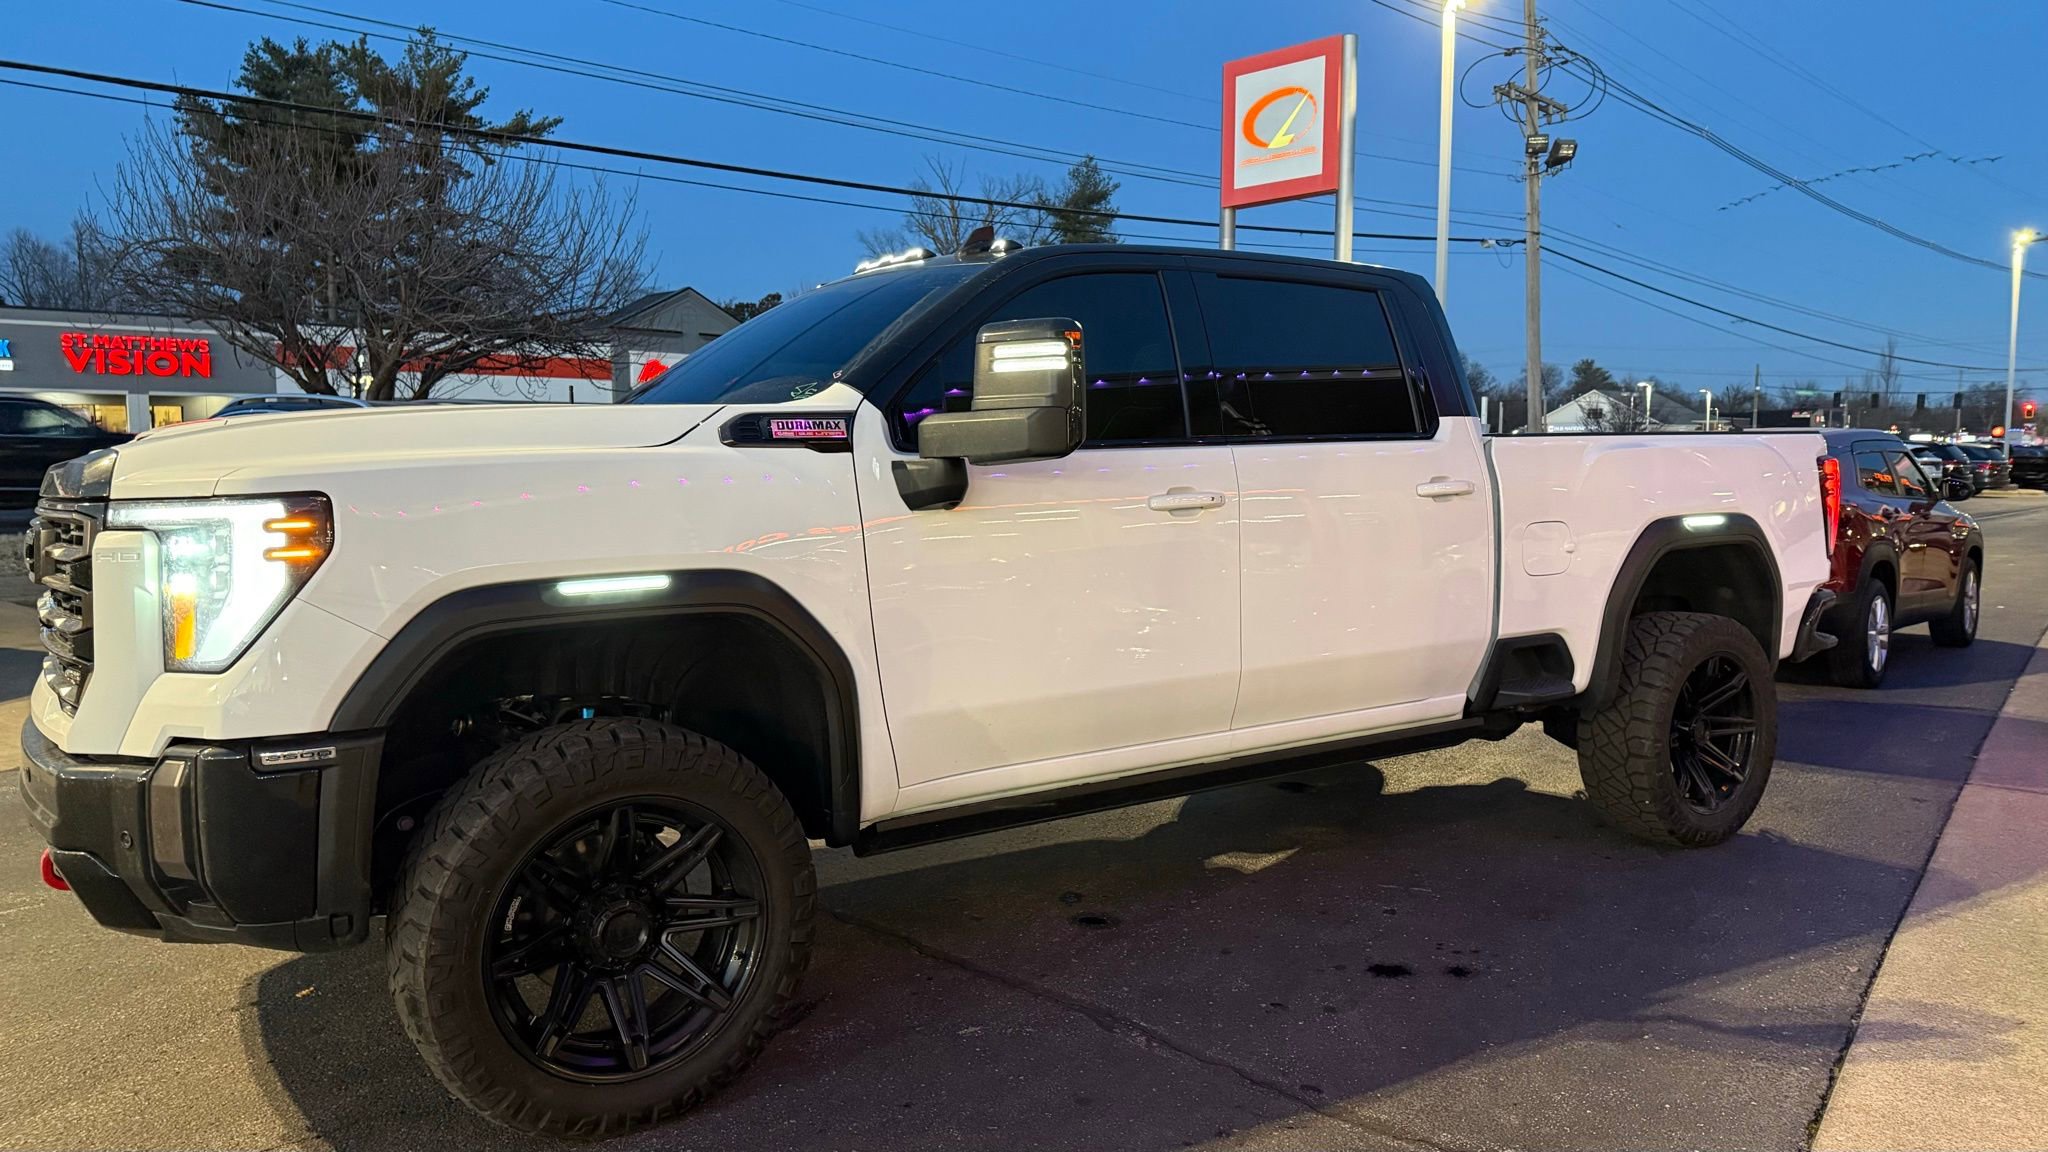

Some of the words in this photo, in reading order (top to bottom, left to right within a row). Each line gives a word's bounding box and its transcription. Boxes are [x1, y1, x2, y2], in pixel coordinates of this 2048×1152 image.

[60, 333, 88, 348] ST.
[93, 335, 210, 353] MATTHEWS
[61, 347, 212, 378] VISION
[776, 420, 842, 430] DURAMAX
